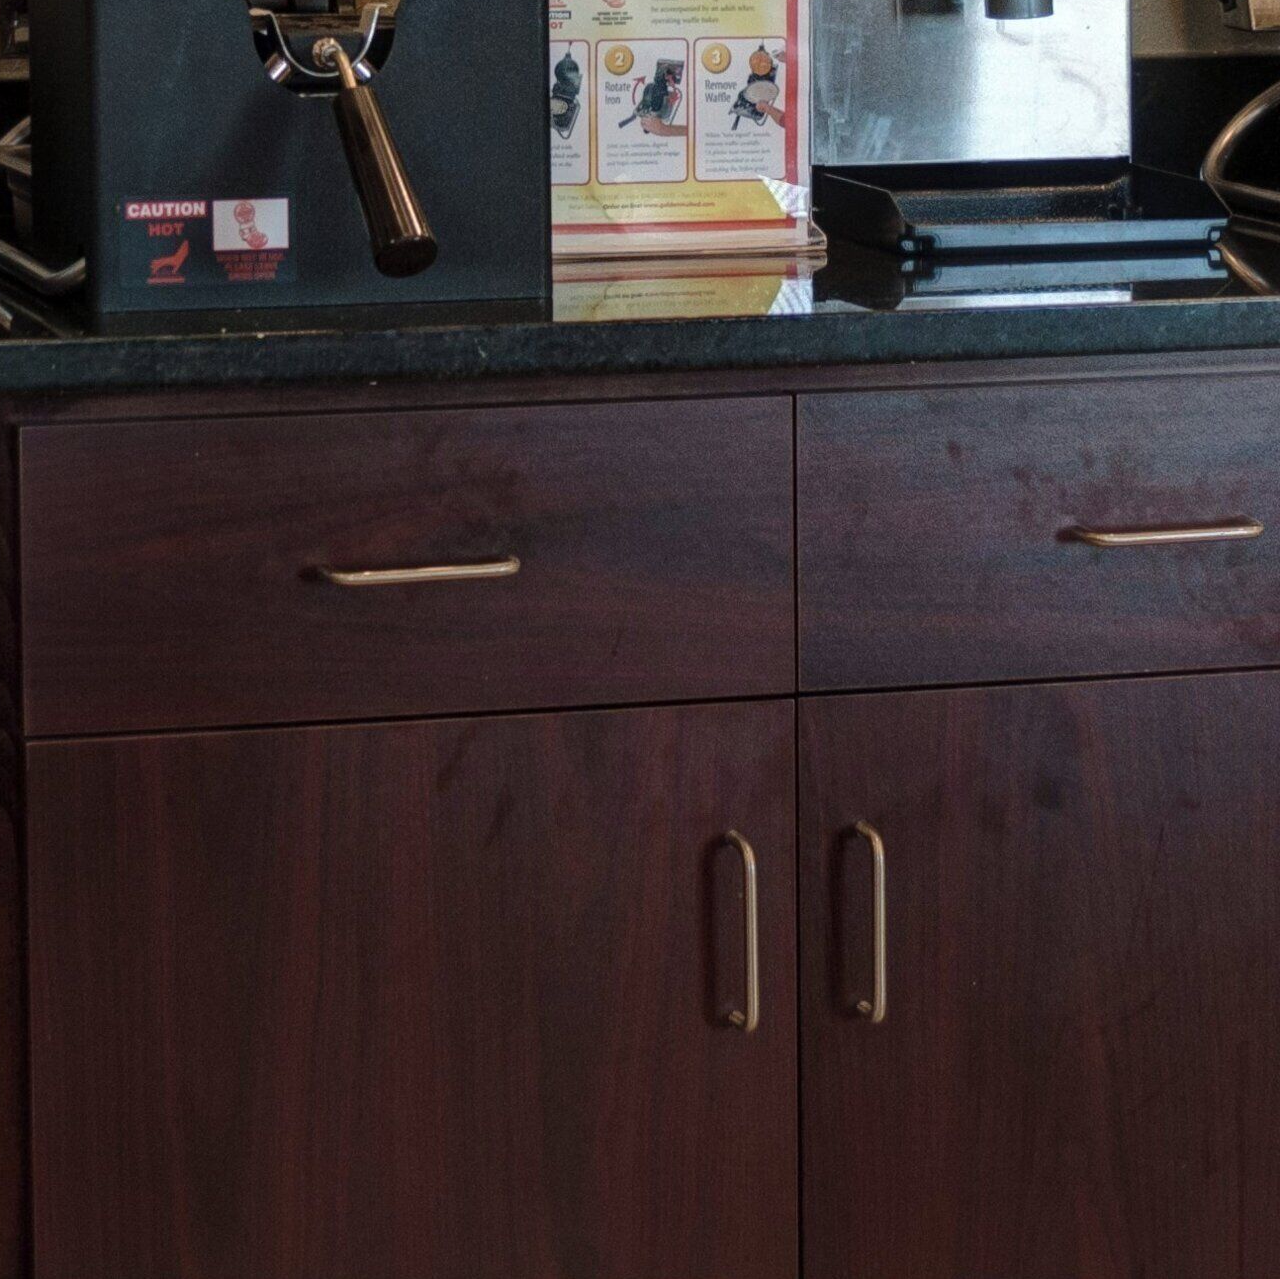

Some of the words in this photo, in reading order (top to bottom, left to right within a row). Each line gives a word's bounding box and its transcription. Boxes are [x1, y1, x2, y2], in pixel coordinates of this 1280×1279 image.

[550, 22, 564, 30] OT
[615, 52, 624, 66] 2
[711, 50, 720, 64] 3
[604, 81, 632, 92] Rotate
[705, 80, 738, 90] Remove
[604, 95, 621, 106] Iron
[704, 93, 732, 104] Waffle
[127, 202, 206, 217] CAUTION
[148, 223, 185, 237] HOT
